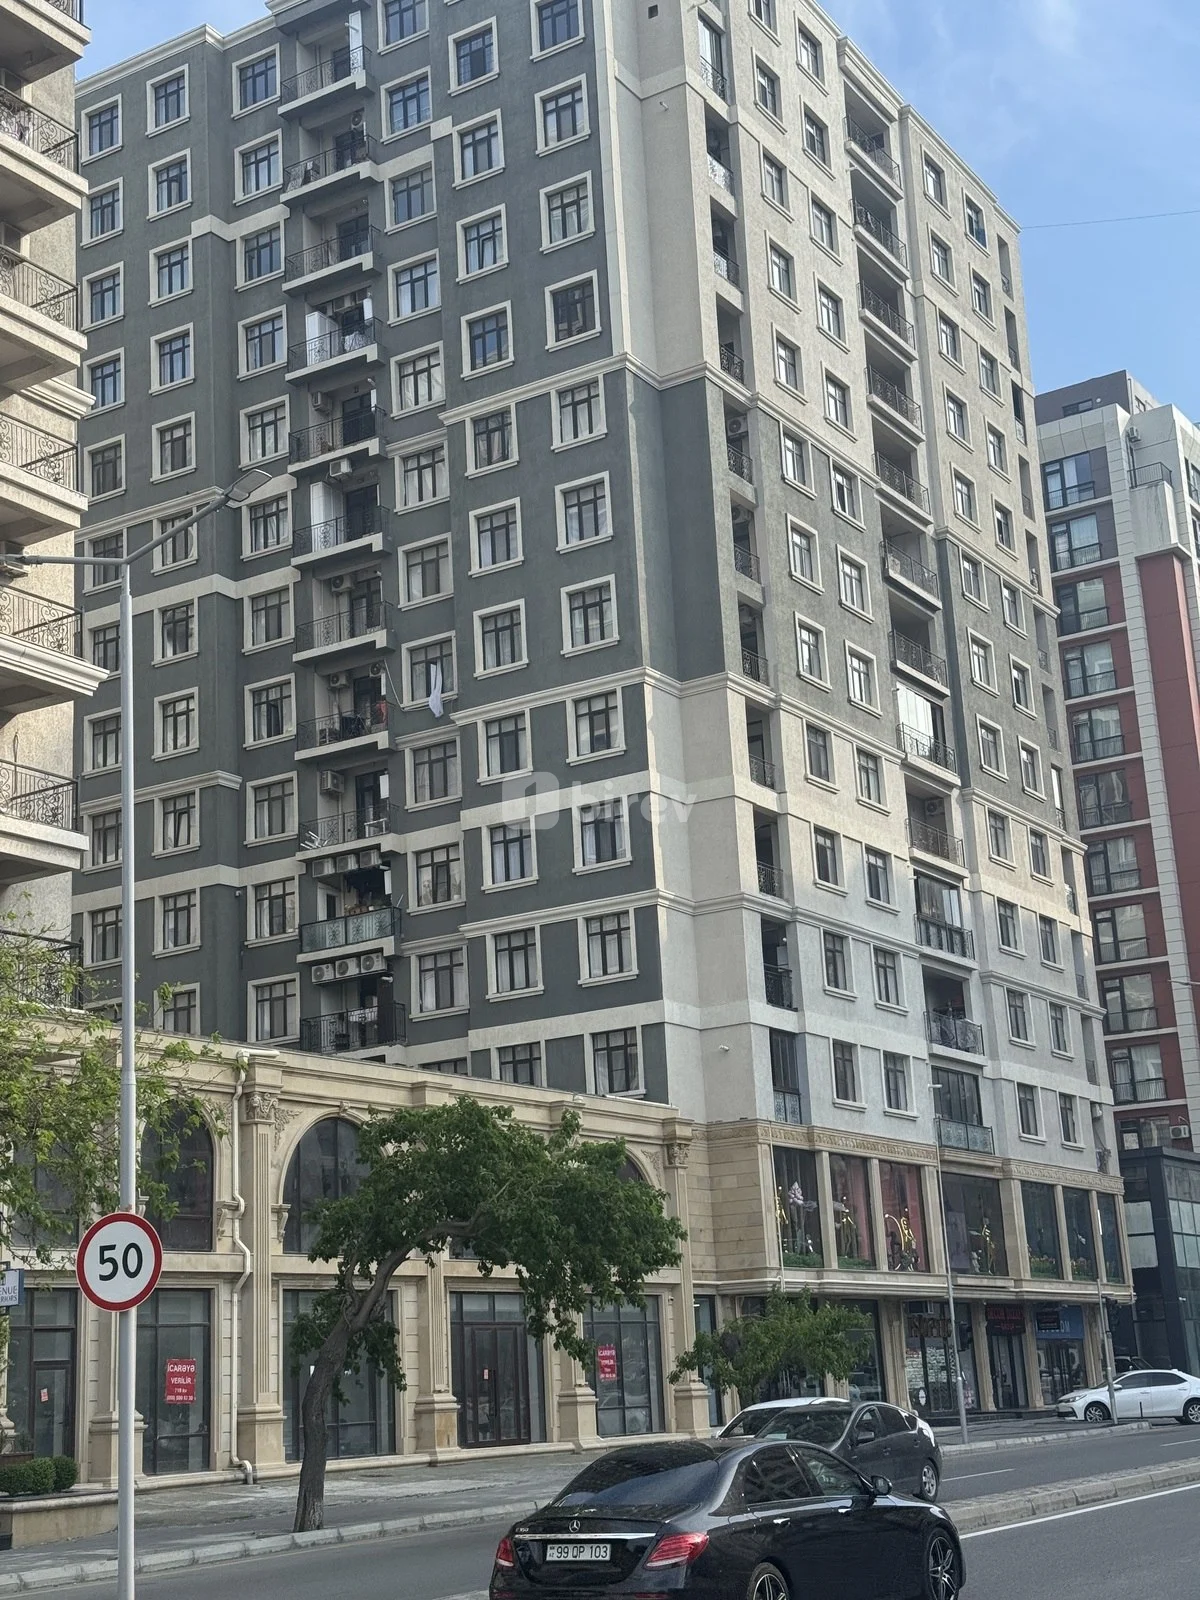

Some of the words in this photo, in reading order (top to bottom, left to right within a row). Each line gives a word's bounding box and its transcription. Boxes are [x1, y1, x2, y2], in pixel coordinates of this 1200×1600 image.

[99, 1242, 143, 1281] 50
[167, 1363, 195, 1372] İCARƏYƏ
[556, 1545, 569, 1559] 99
[589, 1545, 608, 1559] 103
